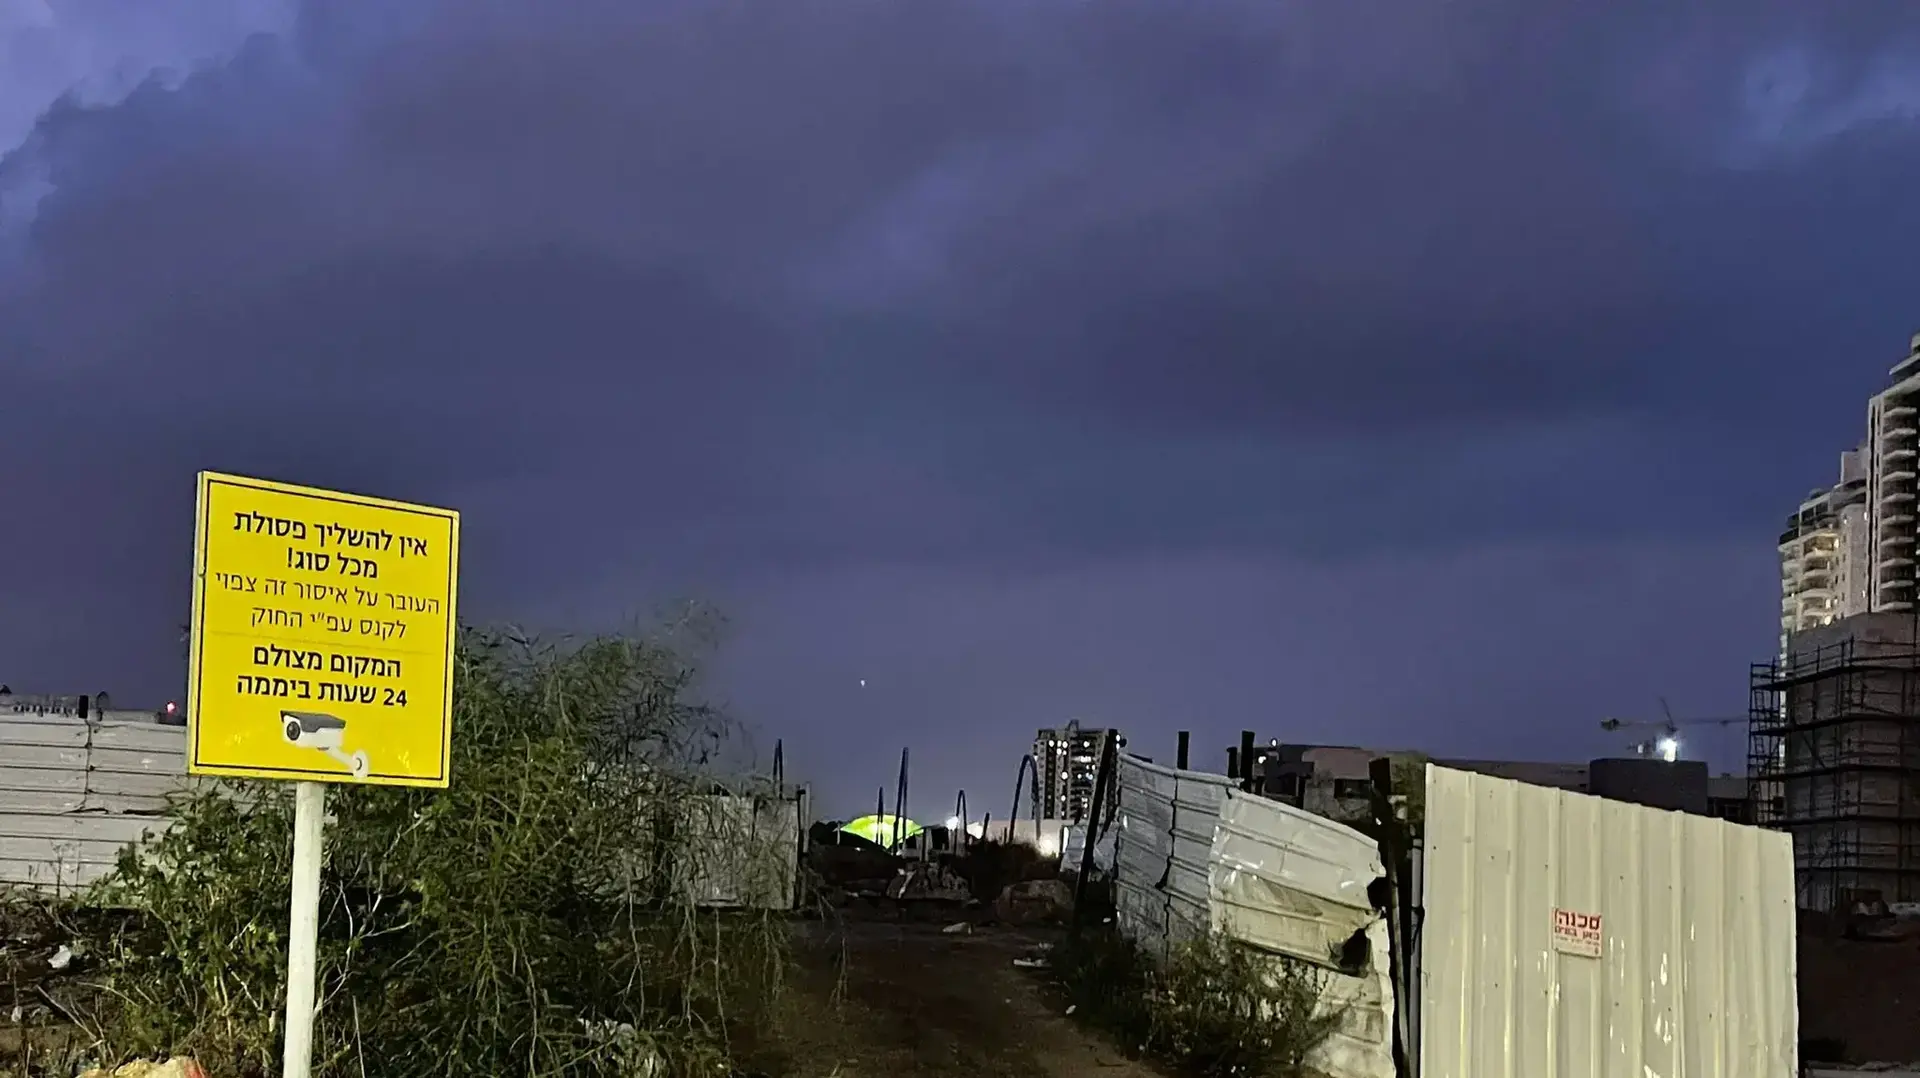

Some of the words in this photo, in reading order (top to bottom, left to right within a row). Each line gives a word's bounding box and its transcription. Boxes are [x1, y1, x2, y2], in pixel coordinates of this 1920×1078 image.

[233, 511, 306, 540] פסולת
[313, 522, 393, 551] להשליך
[399, 536, 428, 557] אין
[287, 547, 330, 572] סוג!
[336, 552, 378, 579] מכל
[215, 572, 257, 593] צפוי
[265, 578, 287, 596] זה
[294, 582, 348, 604] איסור
[354, 586, 378, 607] על
[386, 593, 440, 614] העובר
[252, 607, 303, 628] החוק
[360, 620, 406, 641] לקנס
[253, 643, 323, 671] מצולם
[330, 654, 401, 678] המקום
[237, 675, 311, 699] ביממה
[317, 682, 377, 704] שעות
[383, 688, 408, 707] 24
